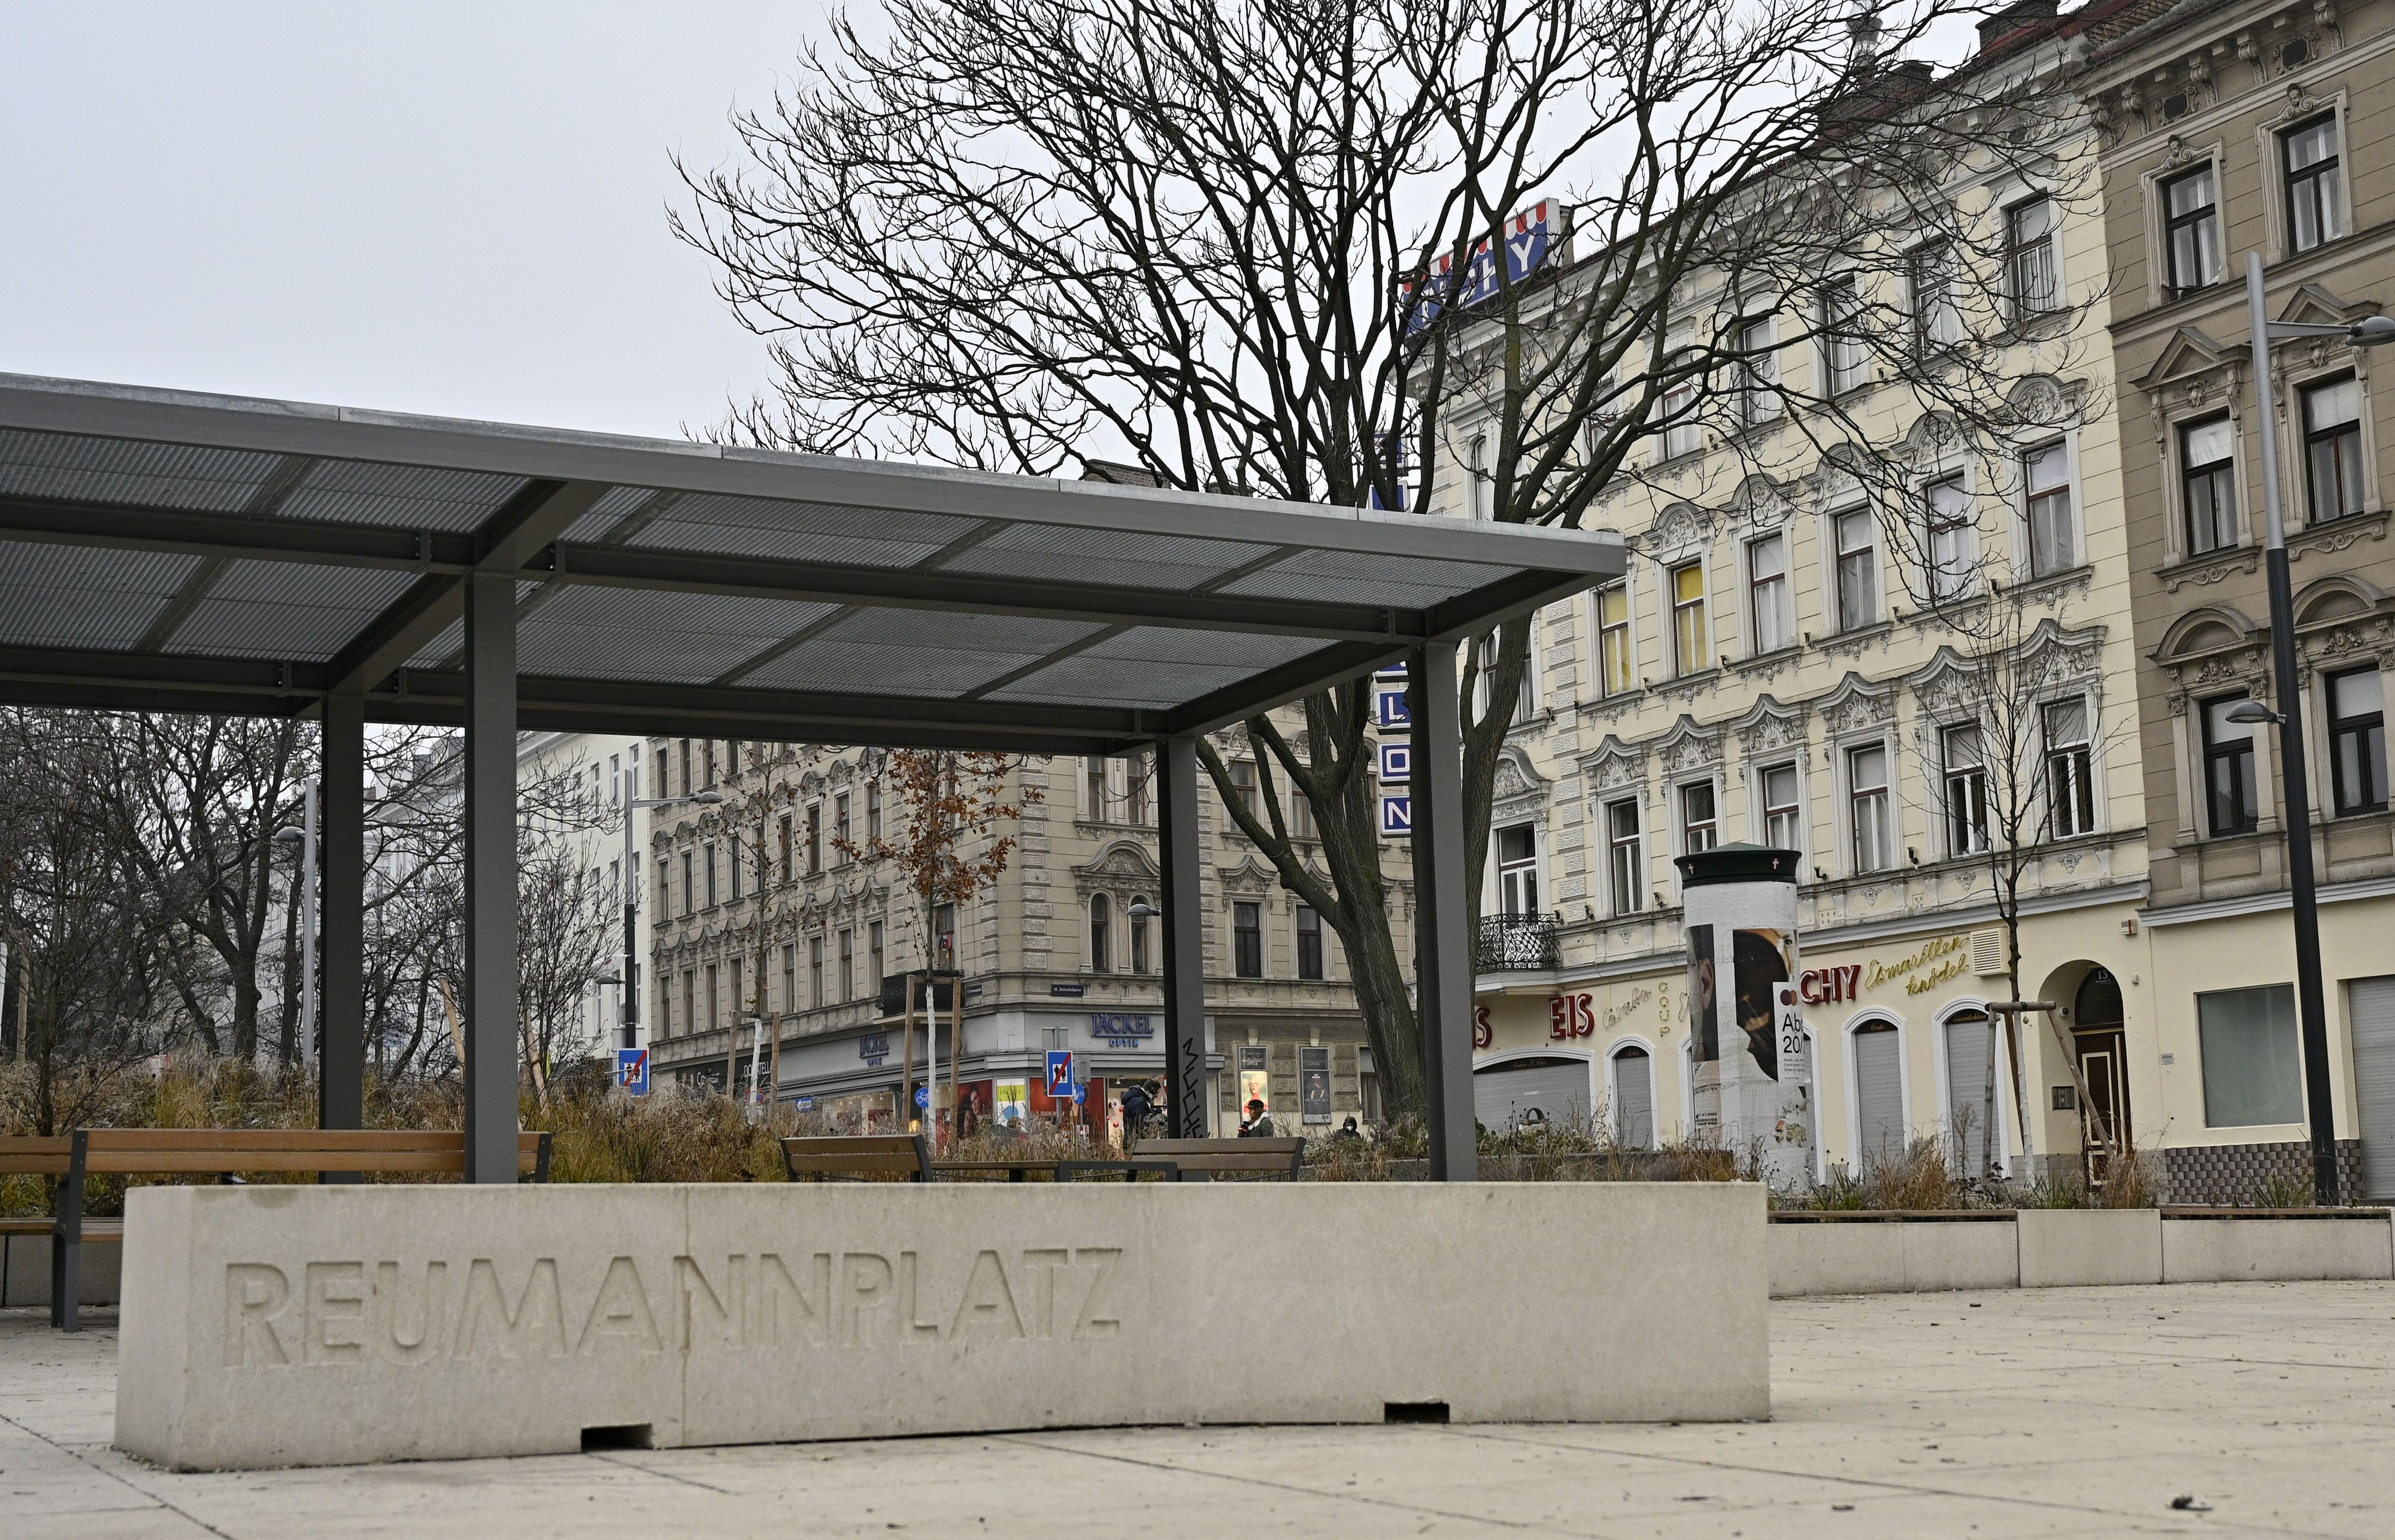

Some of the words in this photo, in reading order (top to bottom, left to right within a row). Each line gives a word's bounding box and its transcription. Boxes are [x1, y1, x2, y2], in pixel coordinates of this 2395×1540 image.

[2097, 969, 2108, 980] 13
[1091, 1013, 1155, 1037] JÄCKEL
[1548, 993, 1595, 1039] EIS
[1109, 1039, 1139, 1047] OPTIK
[222, 1247, 1123, 1367] REUMANNPLATZ
